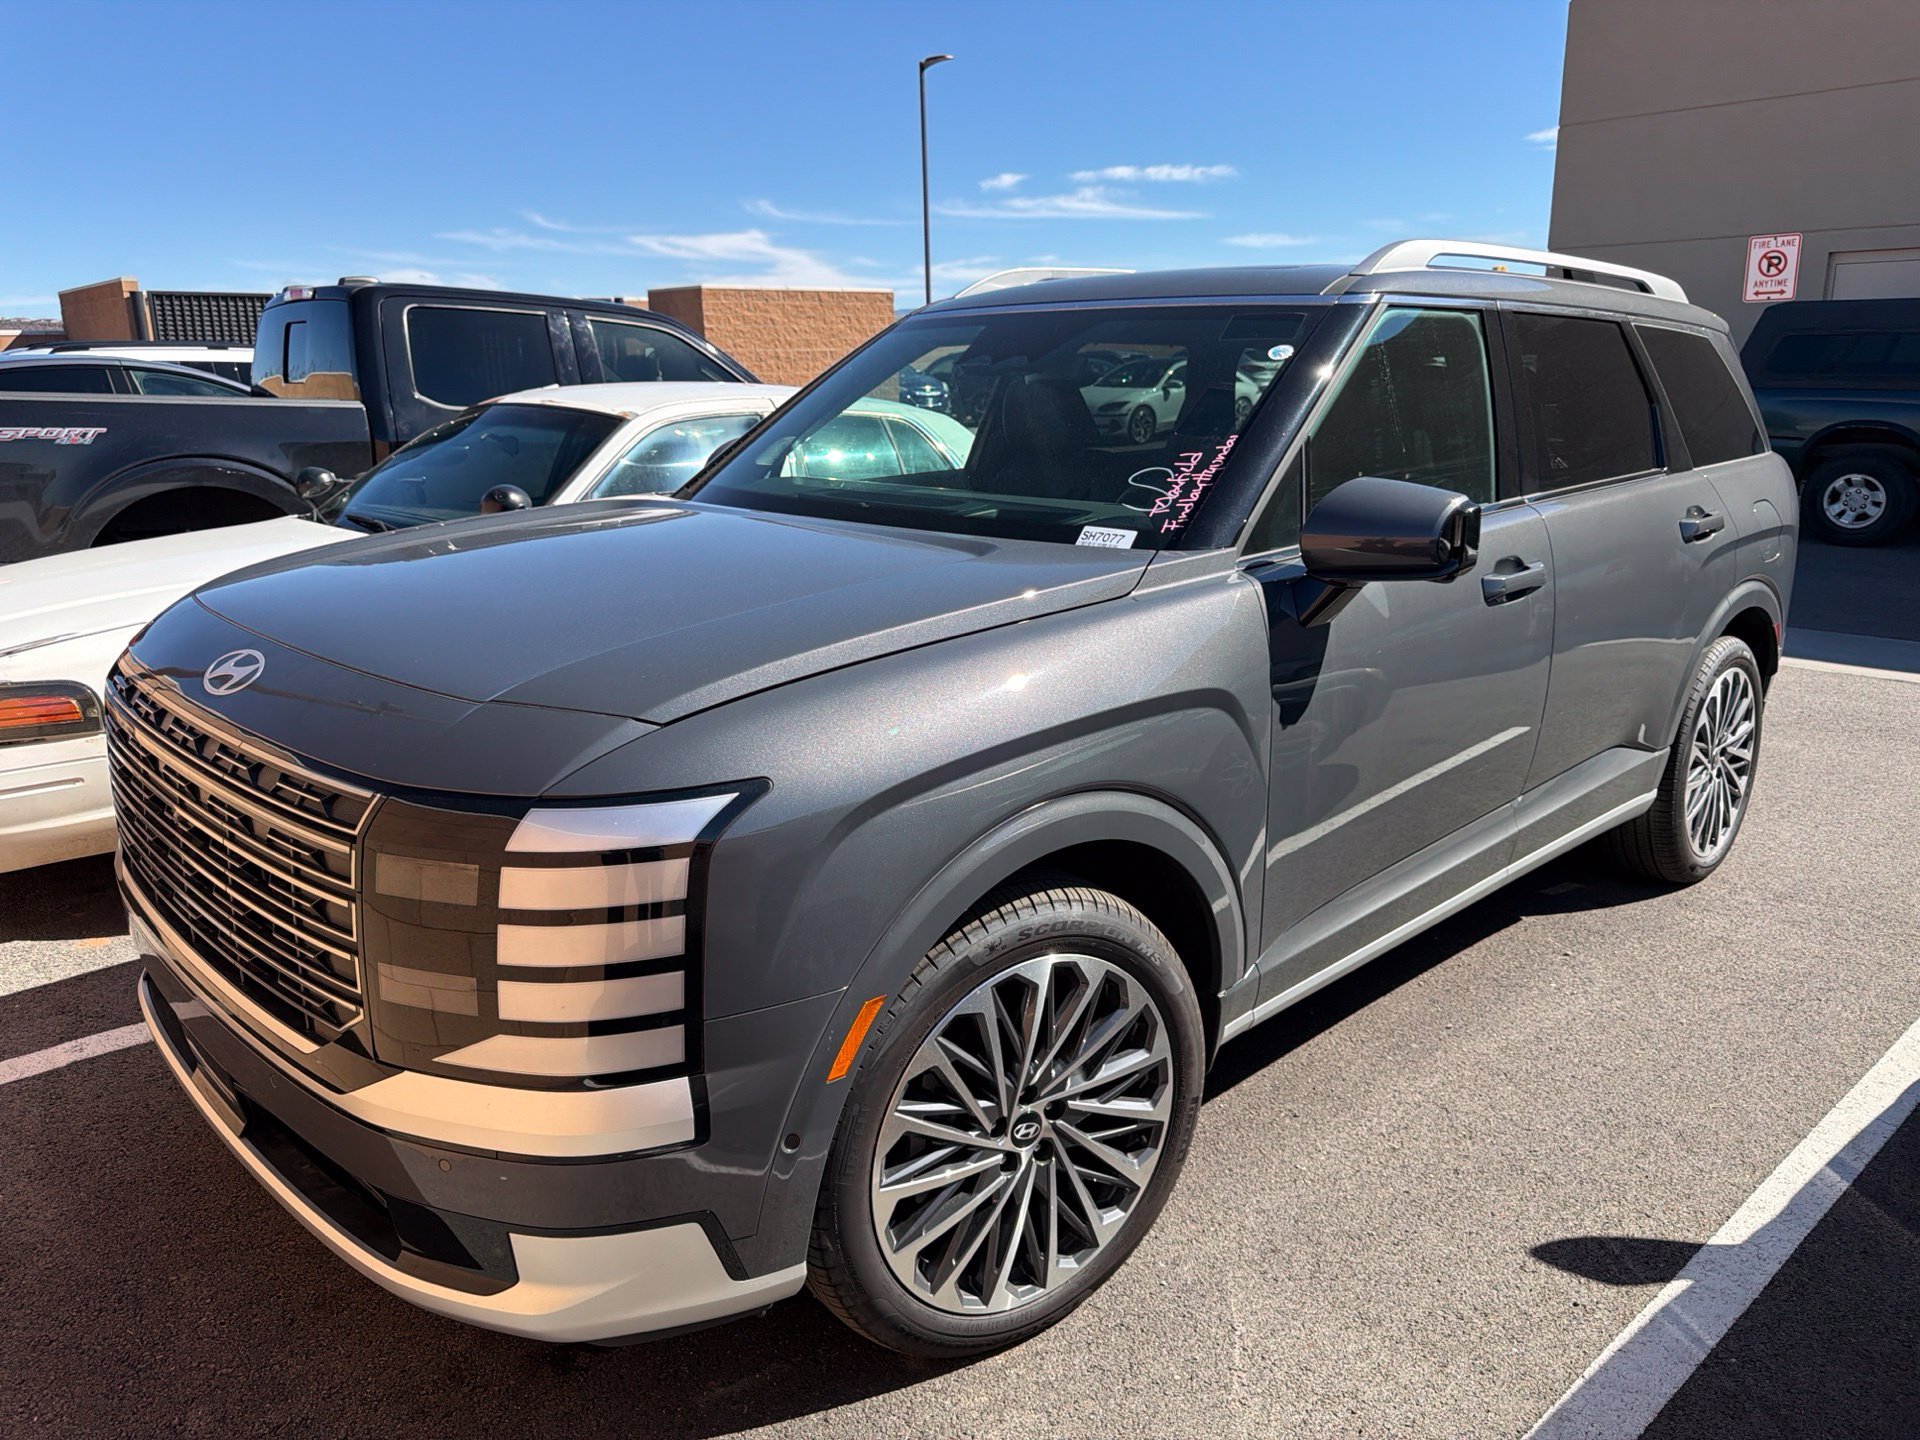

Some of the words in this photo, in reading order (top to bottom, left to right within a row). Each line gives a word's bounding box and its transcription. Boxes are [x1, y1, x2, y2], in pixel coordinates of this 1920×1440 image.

[1753, 240, 1771, 249] FIRE
[1775, 238, 1797, 248] LANE
[1753, 278, 1788, 289] ANYTIME
[0, 427, 107, 441] SPORT
[1080, 530, 1126, 544] SH7077
